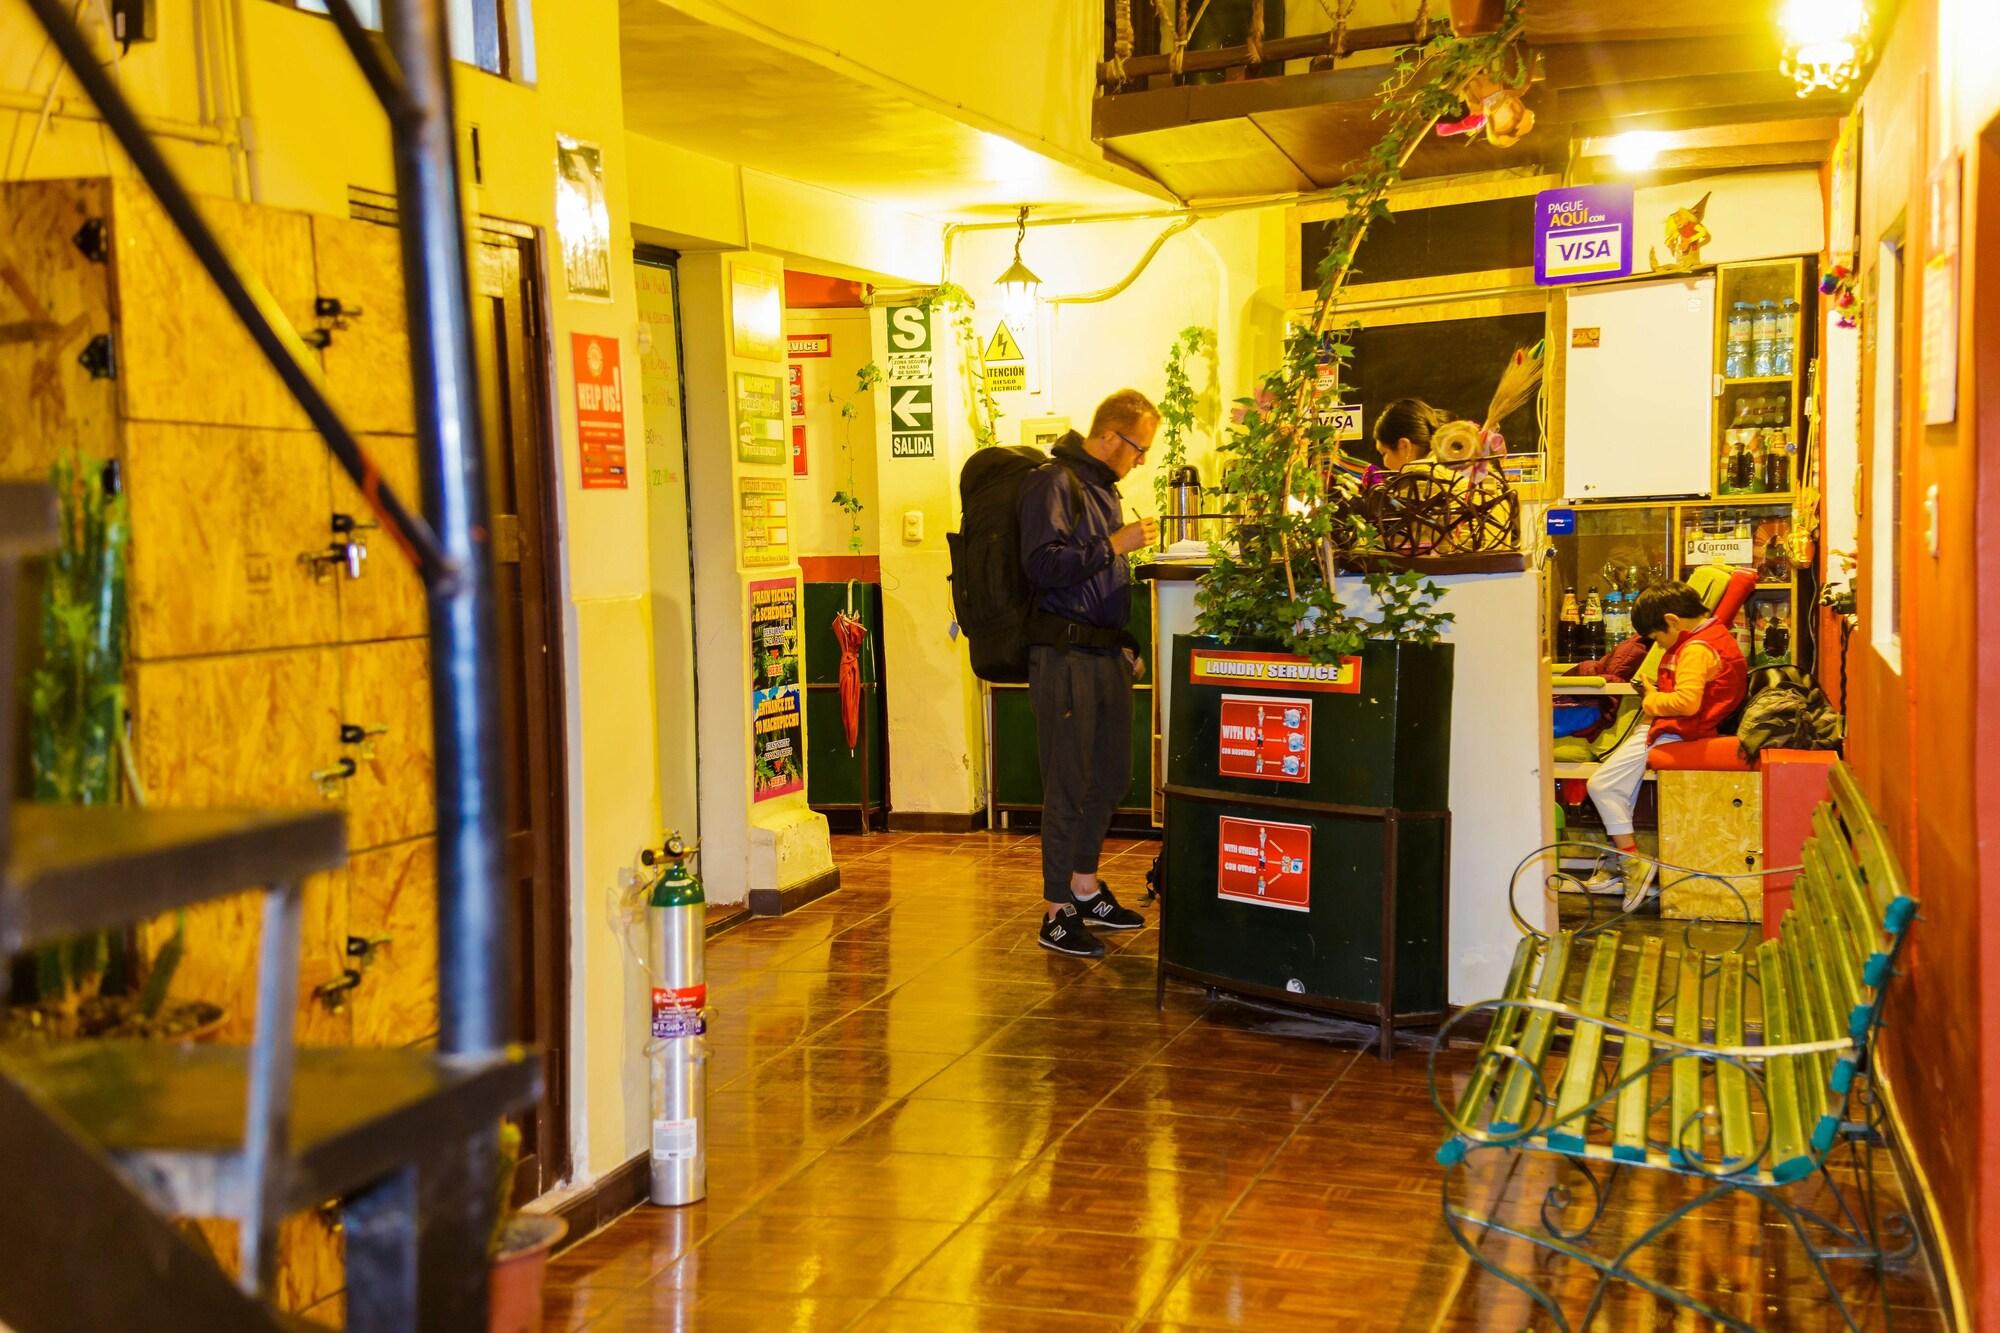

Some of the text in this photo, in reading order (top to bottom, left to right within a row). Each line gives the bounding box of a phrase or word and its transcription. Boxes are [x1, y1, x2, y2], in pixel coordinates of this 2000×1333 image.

[1548, 200, 1584, 214] PAGUE
[1555, 240, 1611, 261] VISA
[892, 306, 926, 349] S
[577, 382, 600, 411] HELP
[602, 366, 621, 413] US!
[893, 436, 932, 455] SALIDA
[1697, 541, 1739, 553] Corona
[752, 587, 795, 605] TRAIN TICKETS
[761, 604, 794, 621] SCHEDULES
[1206, 660, 1338, 681] LAUNDRY SERVICE
[758, 695, 795, 716] ENTRANCE FEE
[755, 719, 763, 735] TO
[1222, 725, 1256, 741] WITH US
[1223, 843, 1258, 856] WITH OTHERS
[1224, 862, 1257, 874] CON OTROS
[1091, 901, 1114, 917] N
[1049, 925, 1067, 941] N
